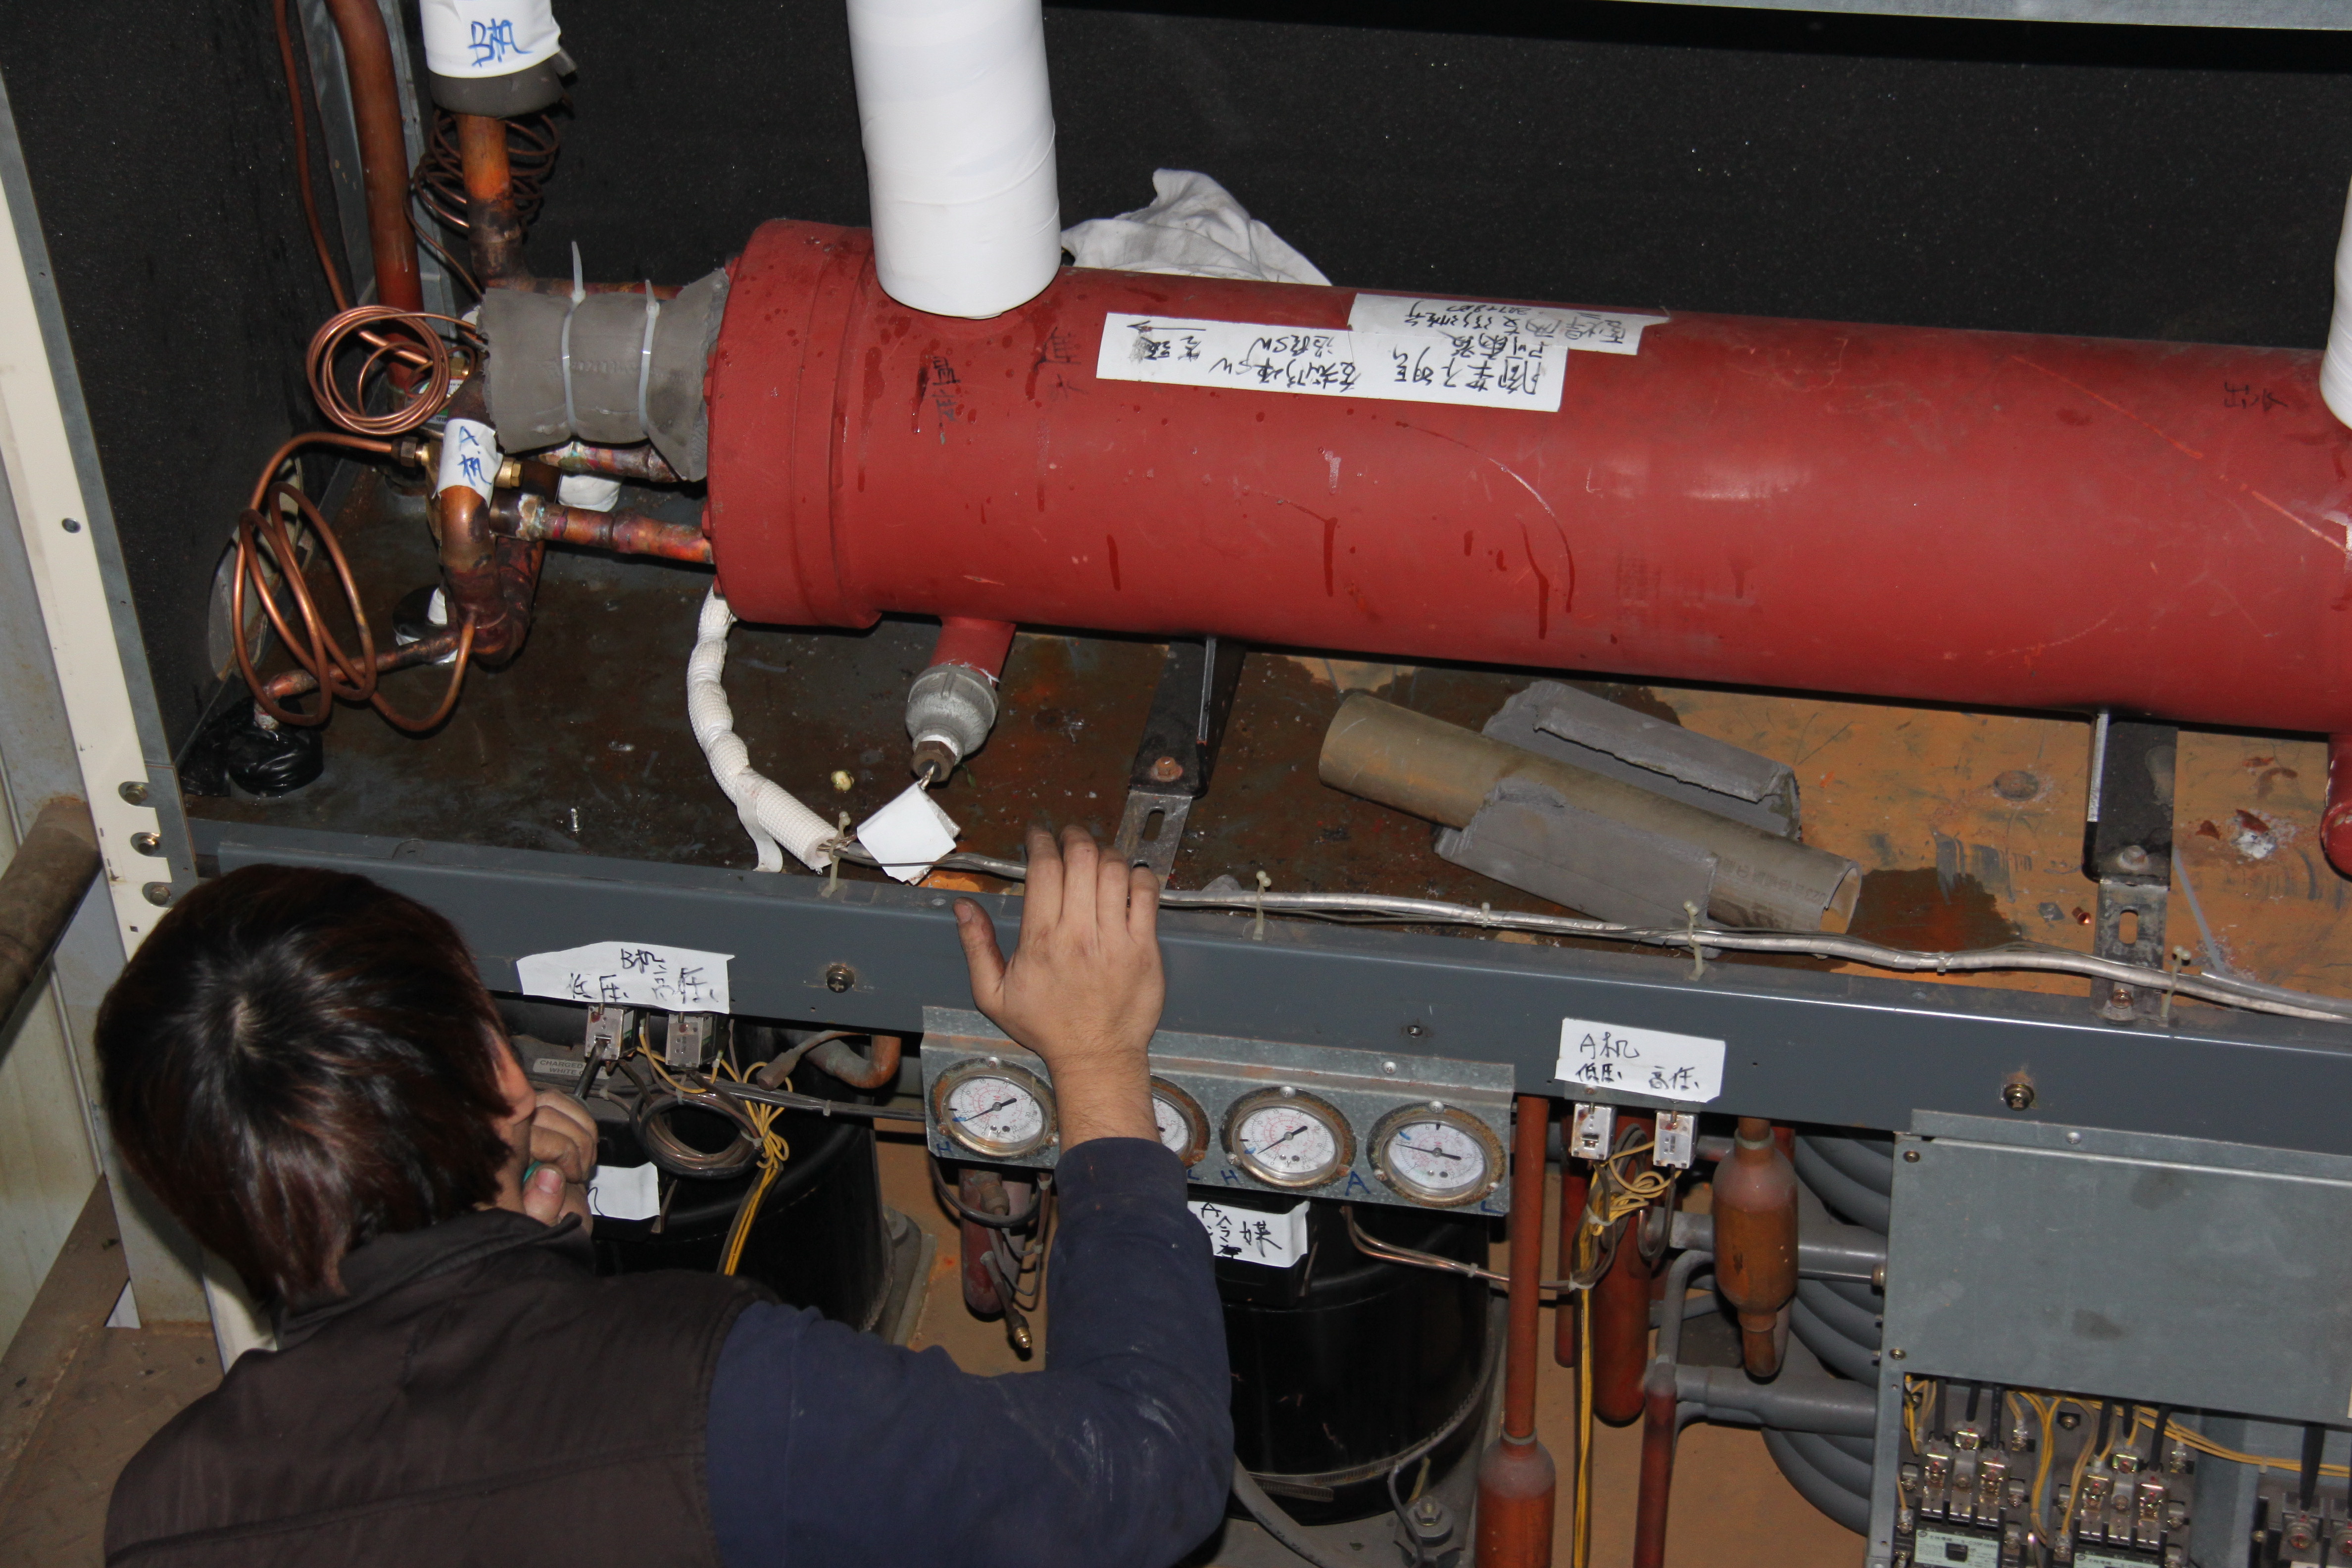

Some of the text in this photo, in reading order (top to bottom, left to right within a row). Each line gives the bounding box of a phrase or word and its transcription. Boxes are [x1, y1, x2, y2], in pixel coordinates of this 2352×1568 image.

[540, 1060, 583, 1069] CHARGED
[1221, 1169, 1241, 1186] H
[1345, 1171, 1371, 1197] A
